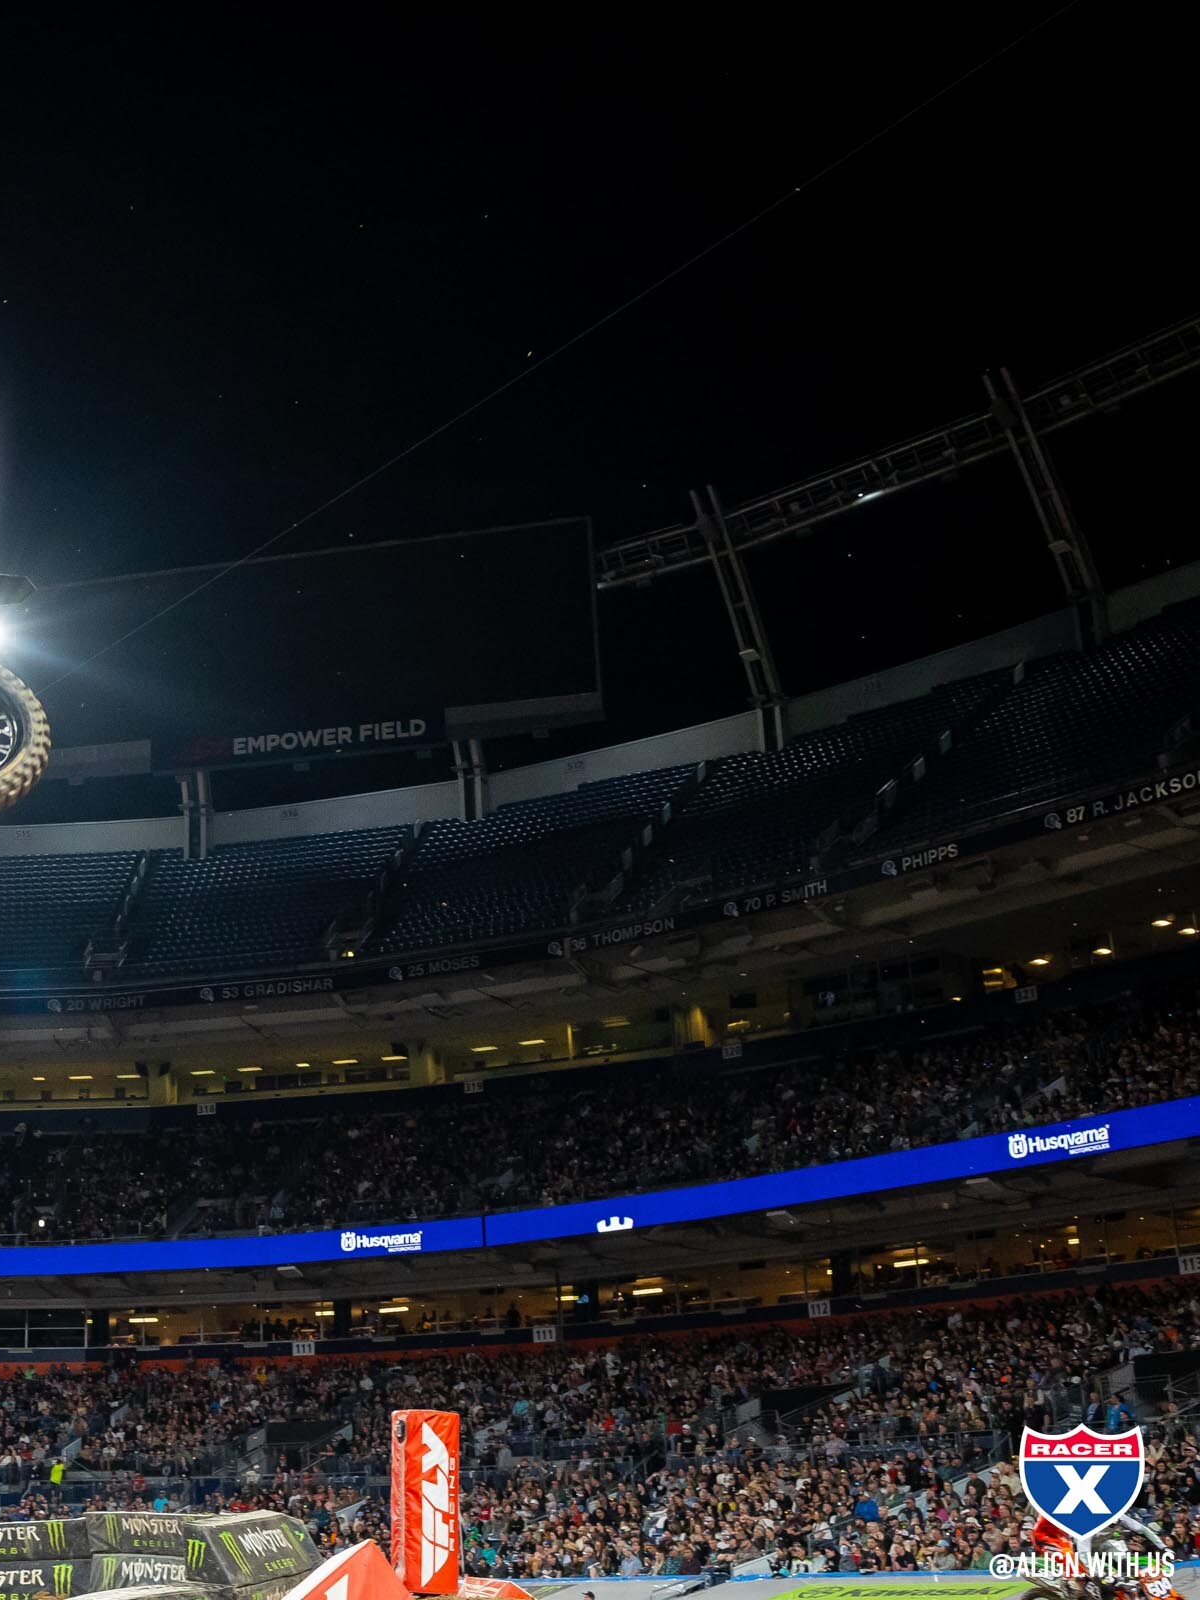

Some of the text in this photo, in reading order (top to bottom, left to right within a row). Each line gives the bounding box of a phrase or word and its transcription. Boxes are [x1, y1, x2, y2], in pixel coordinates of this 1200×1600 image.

[232, 718, 427, 755] EMPOWER FIELD
[1066, 769, 1200, 824] 87 R. JACKSO
[901, 843, 960, 872] PHIPPS
[744, 896, 762, 913] 70
[781, 879, 828, 904] SMITH
[592, 916, 675, 946] THOMPSON
[408, 954, 480, 977] 25 MOSES
[222, 977, 334, 999] 53 GRADISHAR
[88, 994, 146, 1010] WRIGHT
[198, 1104, 215, 1114] 318
[1028, 1126, 1110, 1153] Husqvarna
[356, 1231, 422, 1249] Husqvarna
[810, 1302, 828, 1315] 112
[535, 1329, 553, 1341] 111
[295, 1343, 312, 1354] 111
[448, 1457, 456, 1552] RACING
[122, 1514, 183, 1536] MONSTER
[122, 1558, 187, 1582] MONSTER
[264, 1557, 297, 1573] ENERGY
[838, 1585, 1018, 1597] Kawasaki
